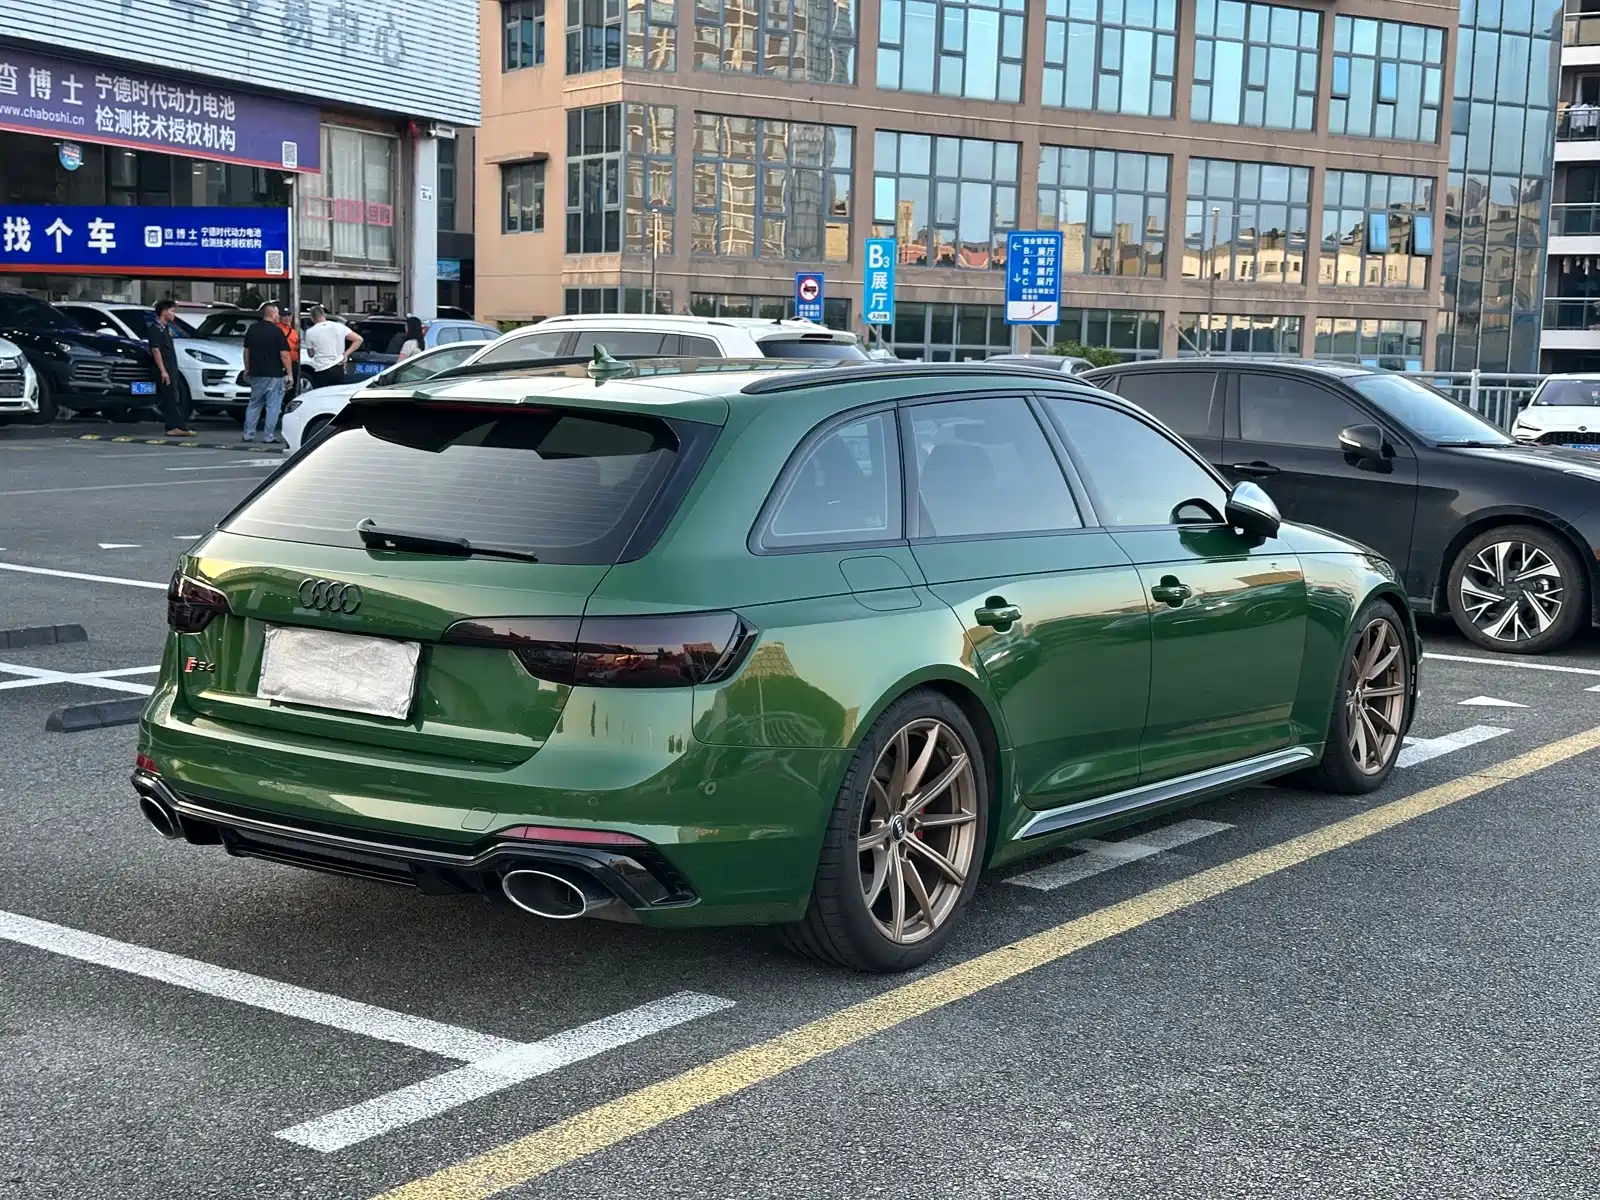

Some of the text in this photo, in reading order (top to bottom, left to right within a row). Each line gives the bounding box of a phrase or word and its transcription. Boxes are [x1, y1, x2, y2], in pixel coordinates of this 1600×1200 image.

[0, 63, 84, 105] 查博士
[95, 73, 236, 122] 宁德时代动力电池
[95, 104, 236, 152] 检测技术授权机构
[3, 216, 117, 254] 找个车
[201, 226, 262, 238] 宁德时代动力电池
[201, 237, 262, 249] 检测技术授权机构
[868, 244, 890, 269] B3
[871, 272, 889, 310] 展厅
